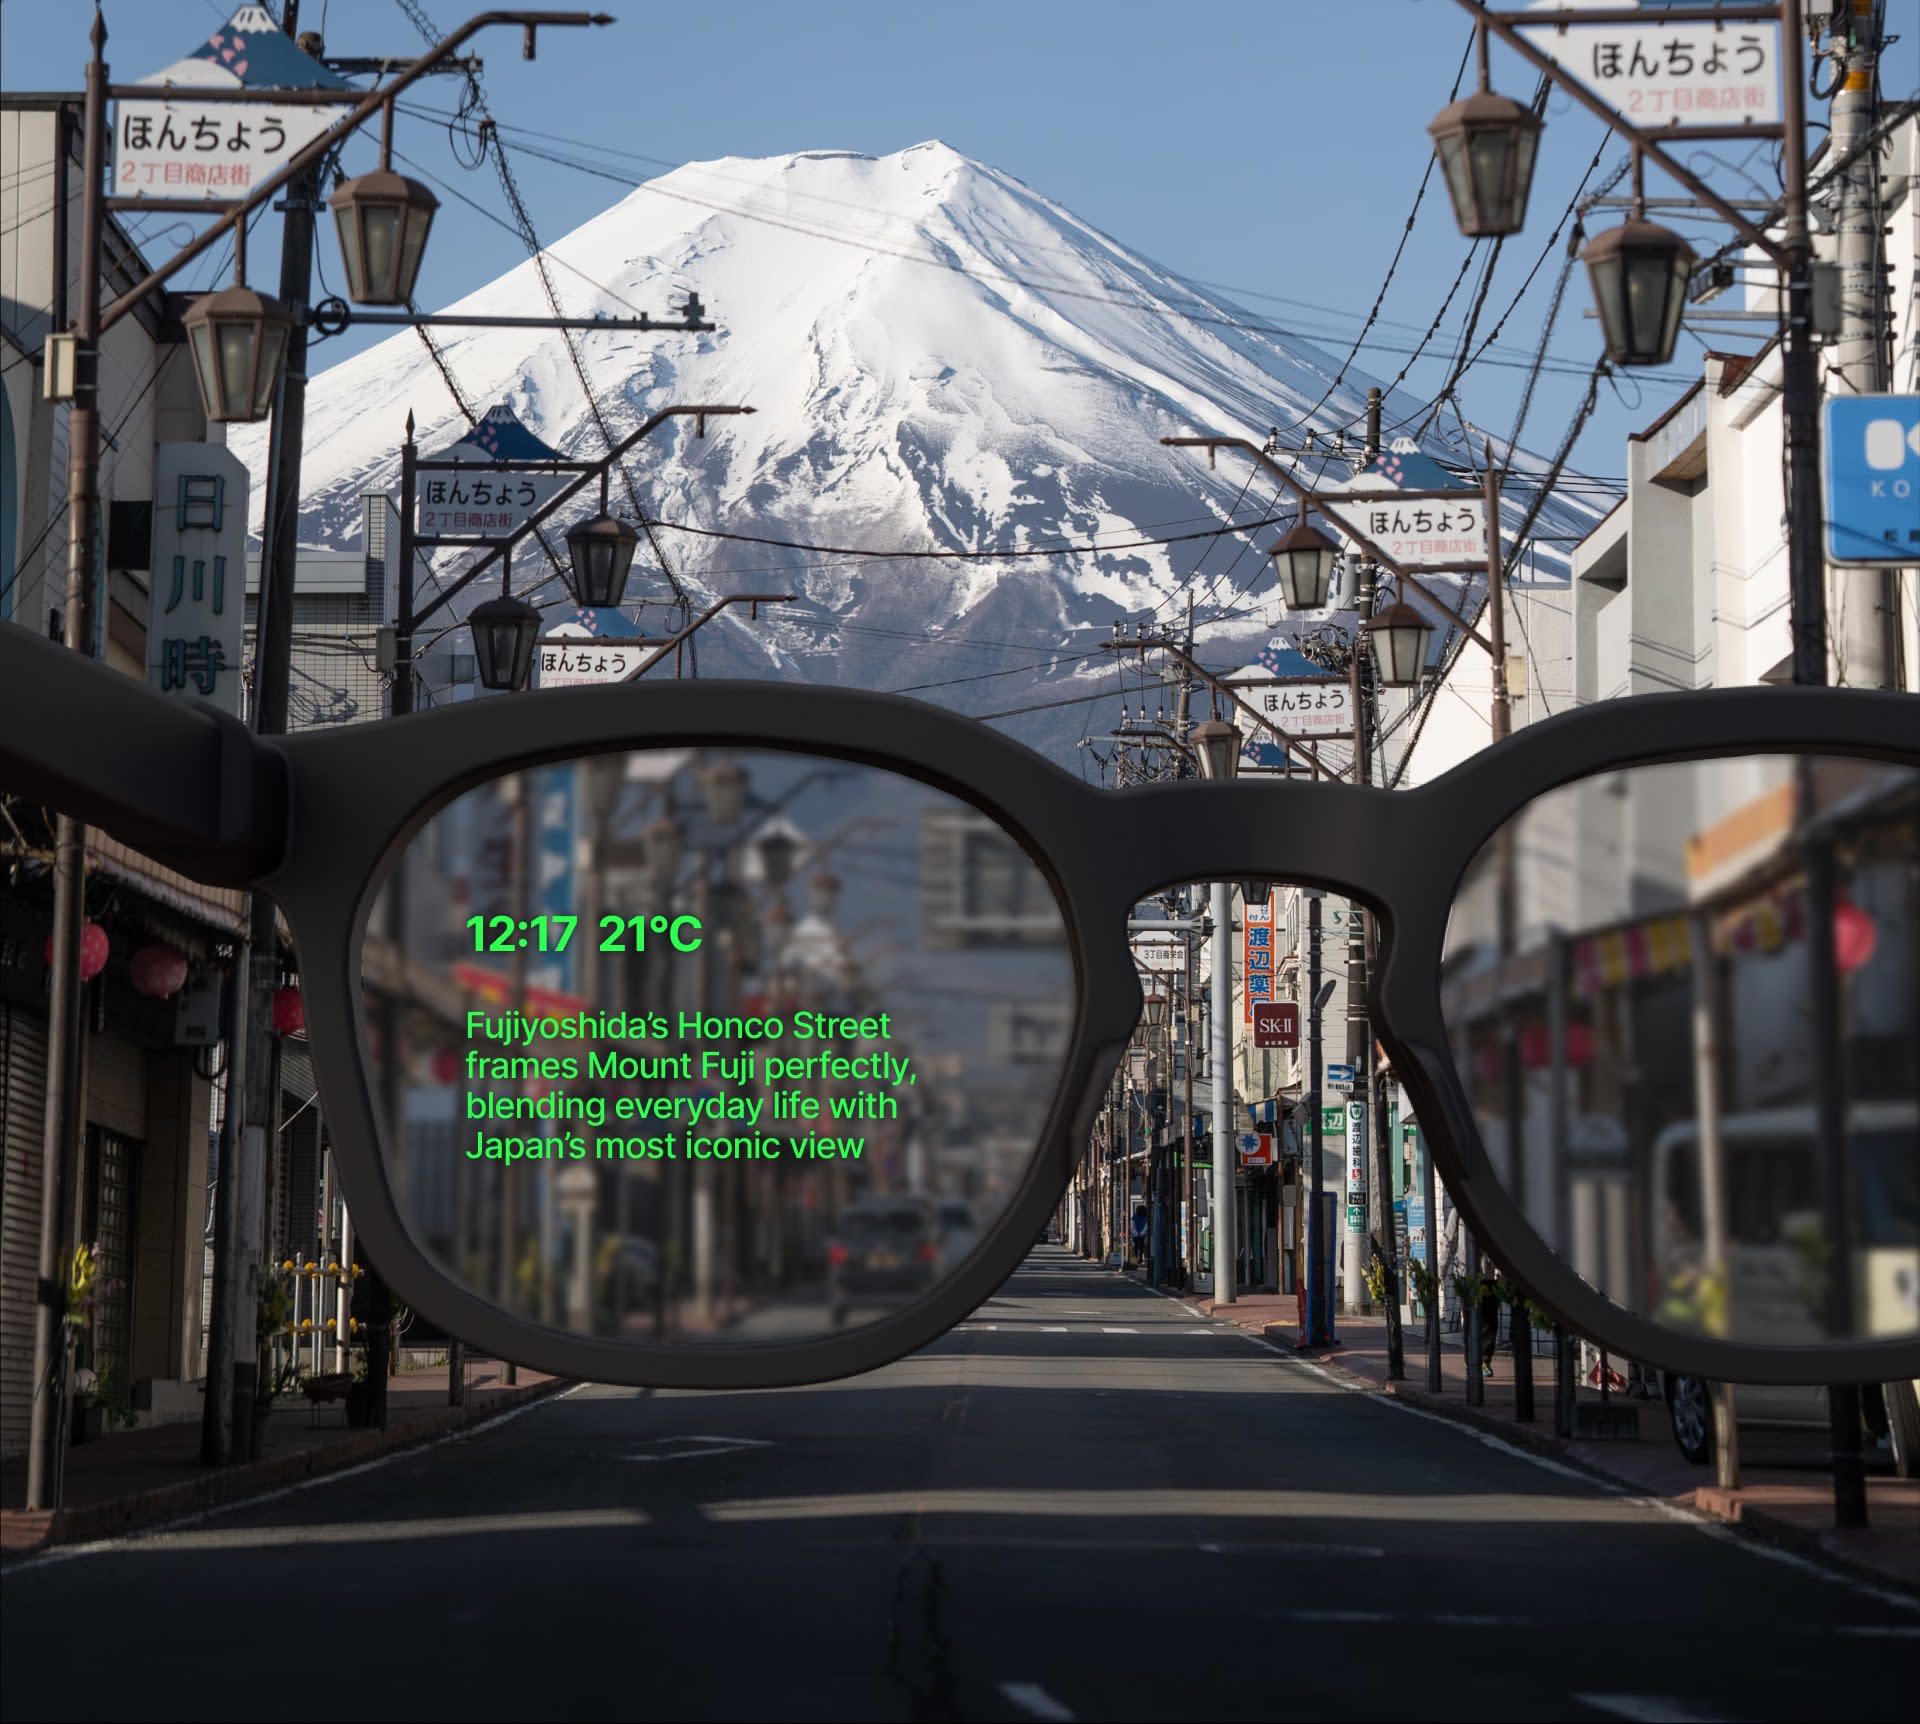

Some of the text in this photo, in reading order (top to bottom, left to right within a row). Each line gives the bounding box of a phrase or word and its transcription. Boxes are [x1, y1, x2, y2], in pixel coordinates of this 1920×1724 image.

[1593, 35, 1765, 79] ほんちょう
[124, 114, 287, 154] ほんちょう
[122, 160, 252, 187] 2丁目商店街
[427, 479, 536, 507] ほんちょう
[426, 511, 513, 528] 2丁目商店街
[1370, 508, 1476, 534] ほんちょう
[541, 652, 626, 674] ほんちょう
[1264, 689, 1344, 713] ほんちょう
[1259, 1018, 1292, 1033] SK-II
